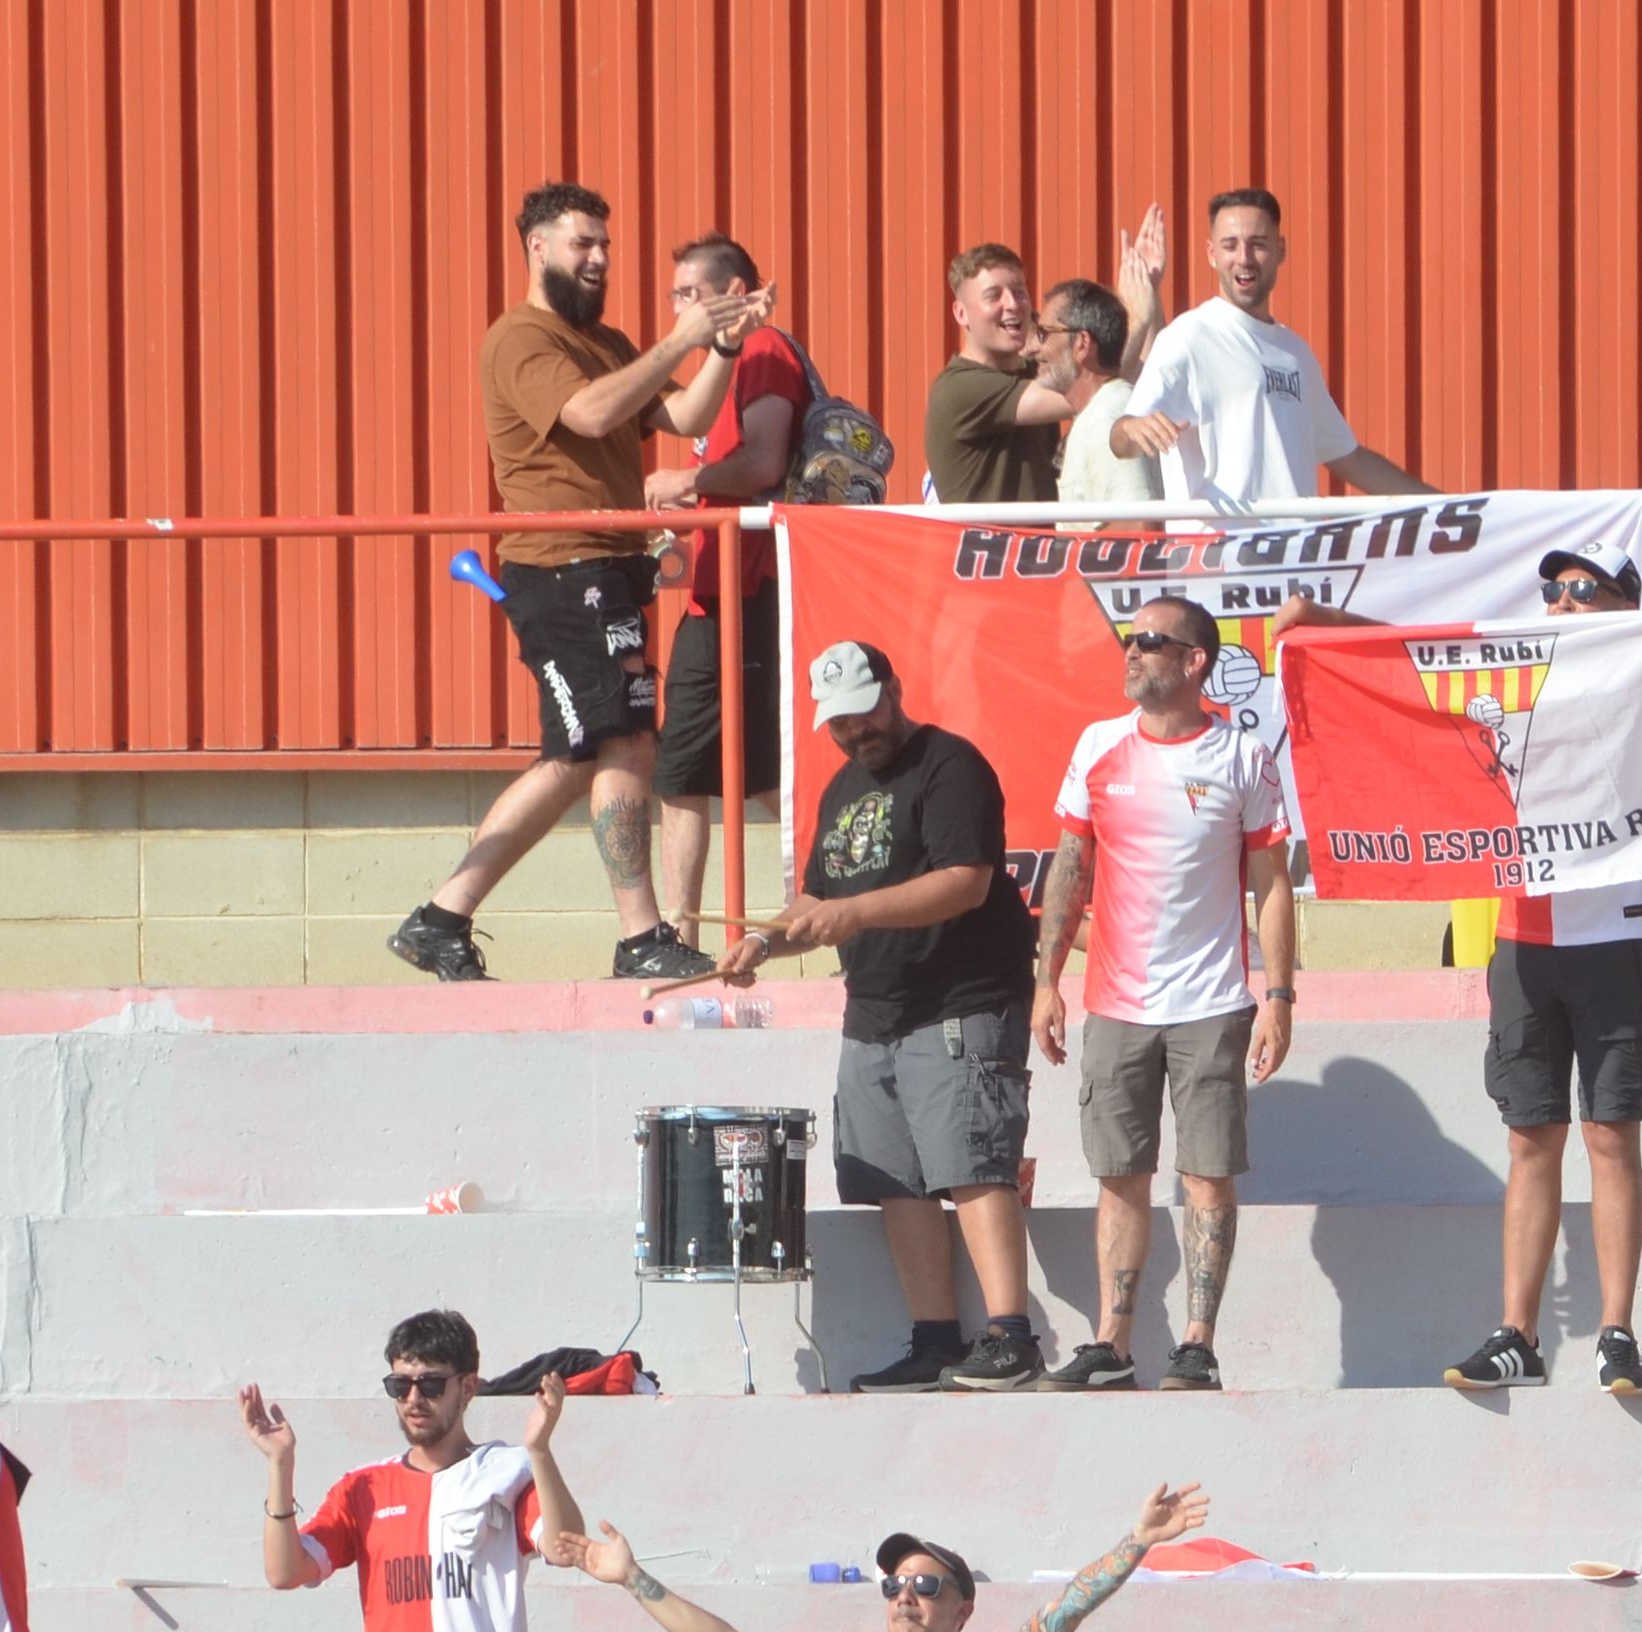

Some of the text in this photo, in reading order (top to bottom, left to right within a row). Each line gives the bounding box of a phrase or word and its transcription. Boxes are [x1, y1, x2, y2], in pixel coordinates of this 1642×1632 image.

[1261, 363, 1301, 402] EVERLAST
[1417, 644, 1471, 667] U.E.
[1328, 824, 1412, 864] UNIÓ
[1421, 818, 1619, 864] ESPORTIVA
[1494, 858, 1557, 889] 1912
[384, 1554, 434, 1606] ROBIN
